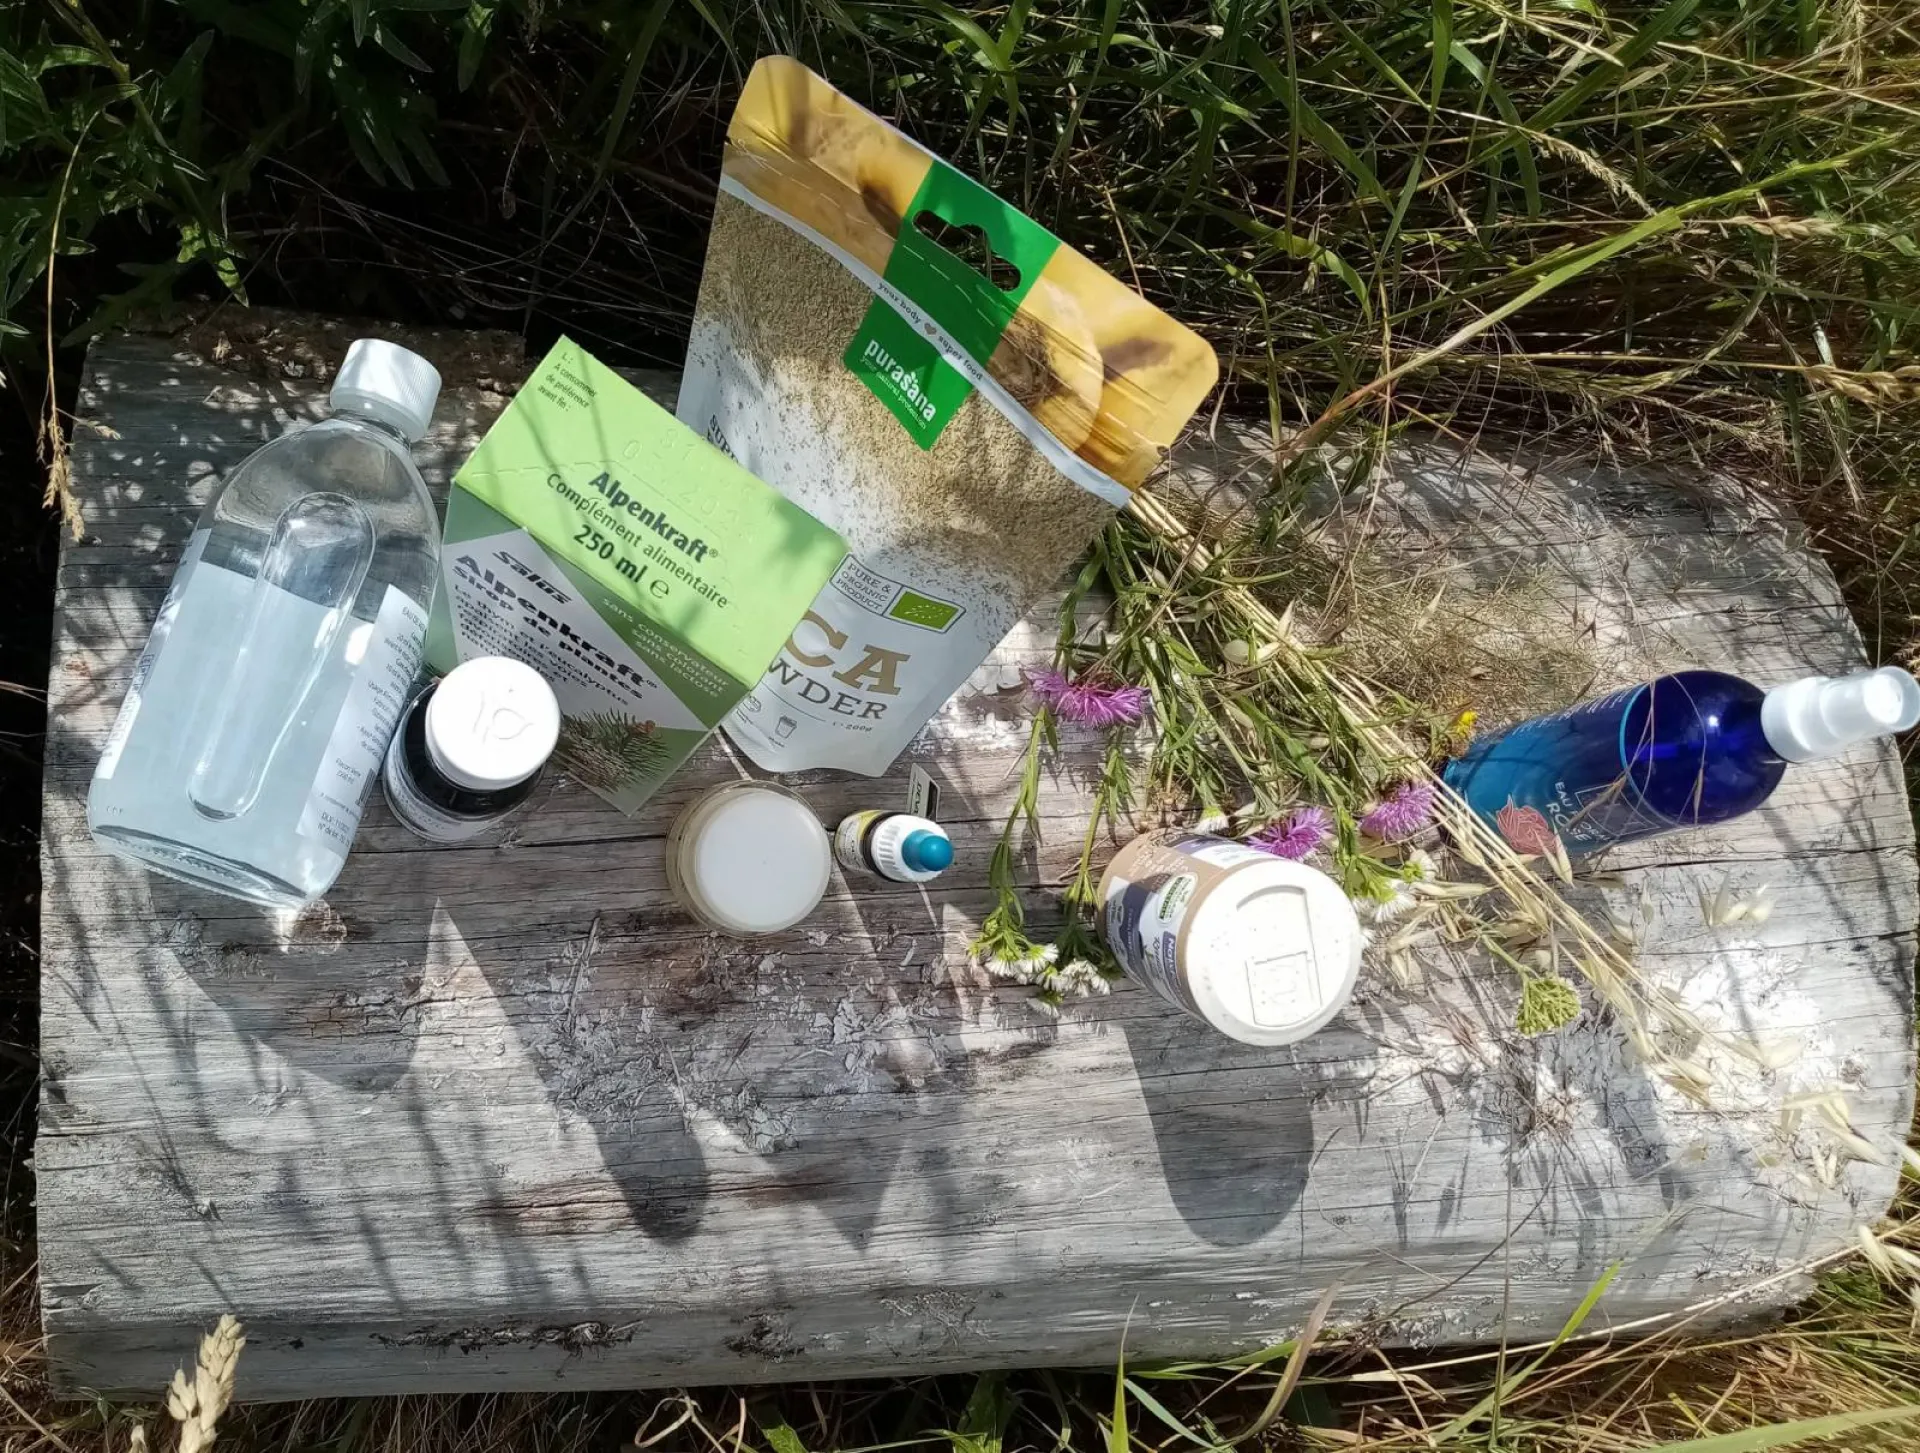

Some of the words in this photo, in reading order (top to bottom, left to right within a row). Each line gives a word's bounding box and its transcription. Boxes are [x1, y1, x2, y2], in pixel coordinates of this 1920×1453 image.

[878, 283, 899, 301] your
[900, 301, 922, 324] body
[939, 335, 963, 360] super
[963, 359, 983, 380] food
[560, 368, 598, 397] consommer
[863, 338, 936, 422] purasana
[546, 473, 641, 549] Complément
[643, 540, 729, 610] alimentaire
[573, 525, 616, 561] 250
[615, 552, 646, 585] ml
[492, 551, 572, 604] Salus
[836, 577, 882, 610] PRODUCT
[840, 570, 888, 602] ORGANIC
[847, 562, 881, 588] PURE
[453, 566, 514, 611] Sirop
[523, 616, 551, 637] de
[558, 640, 644, 699] plantes
[602, 598, 634, 622] sans
[638, 622, 729, 687] conservateur
[1554, 781, 1572, 808] EAU
